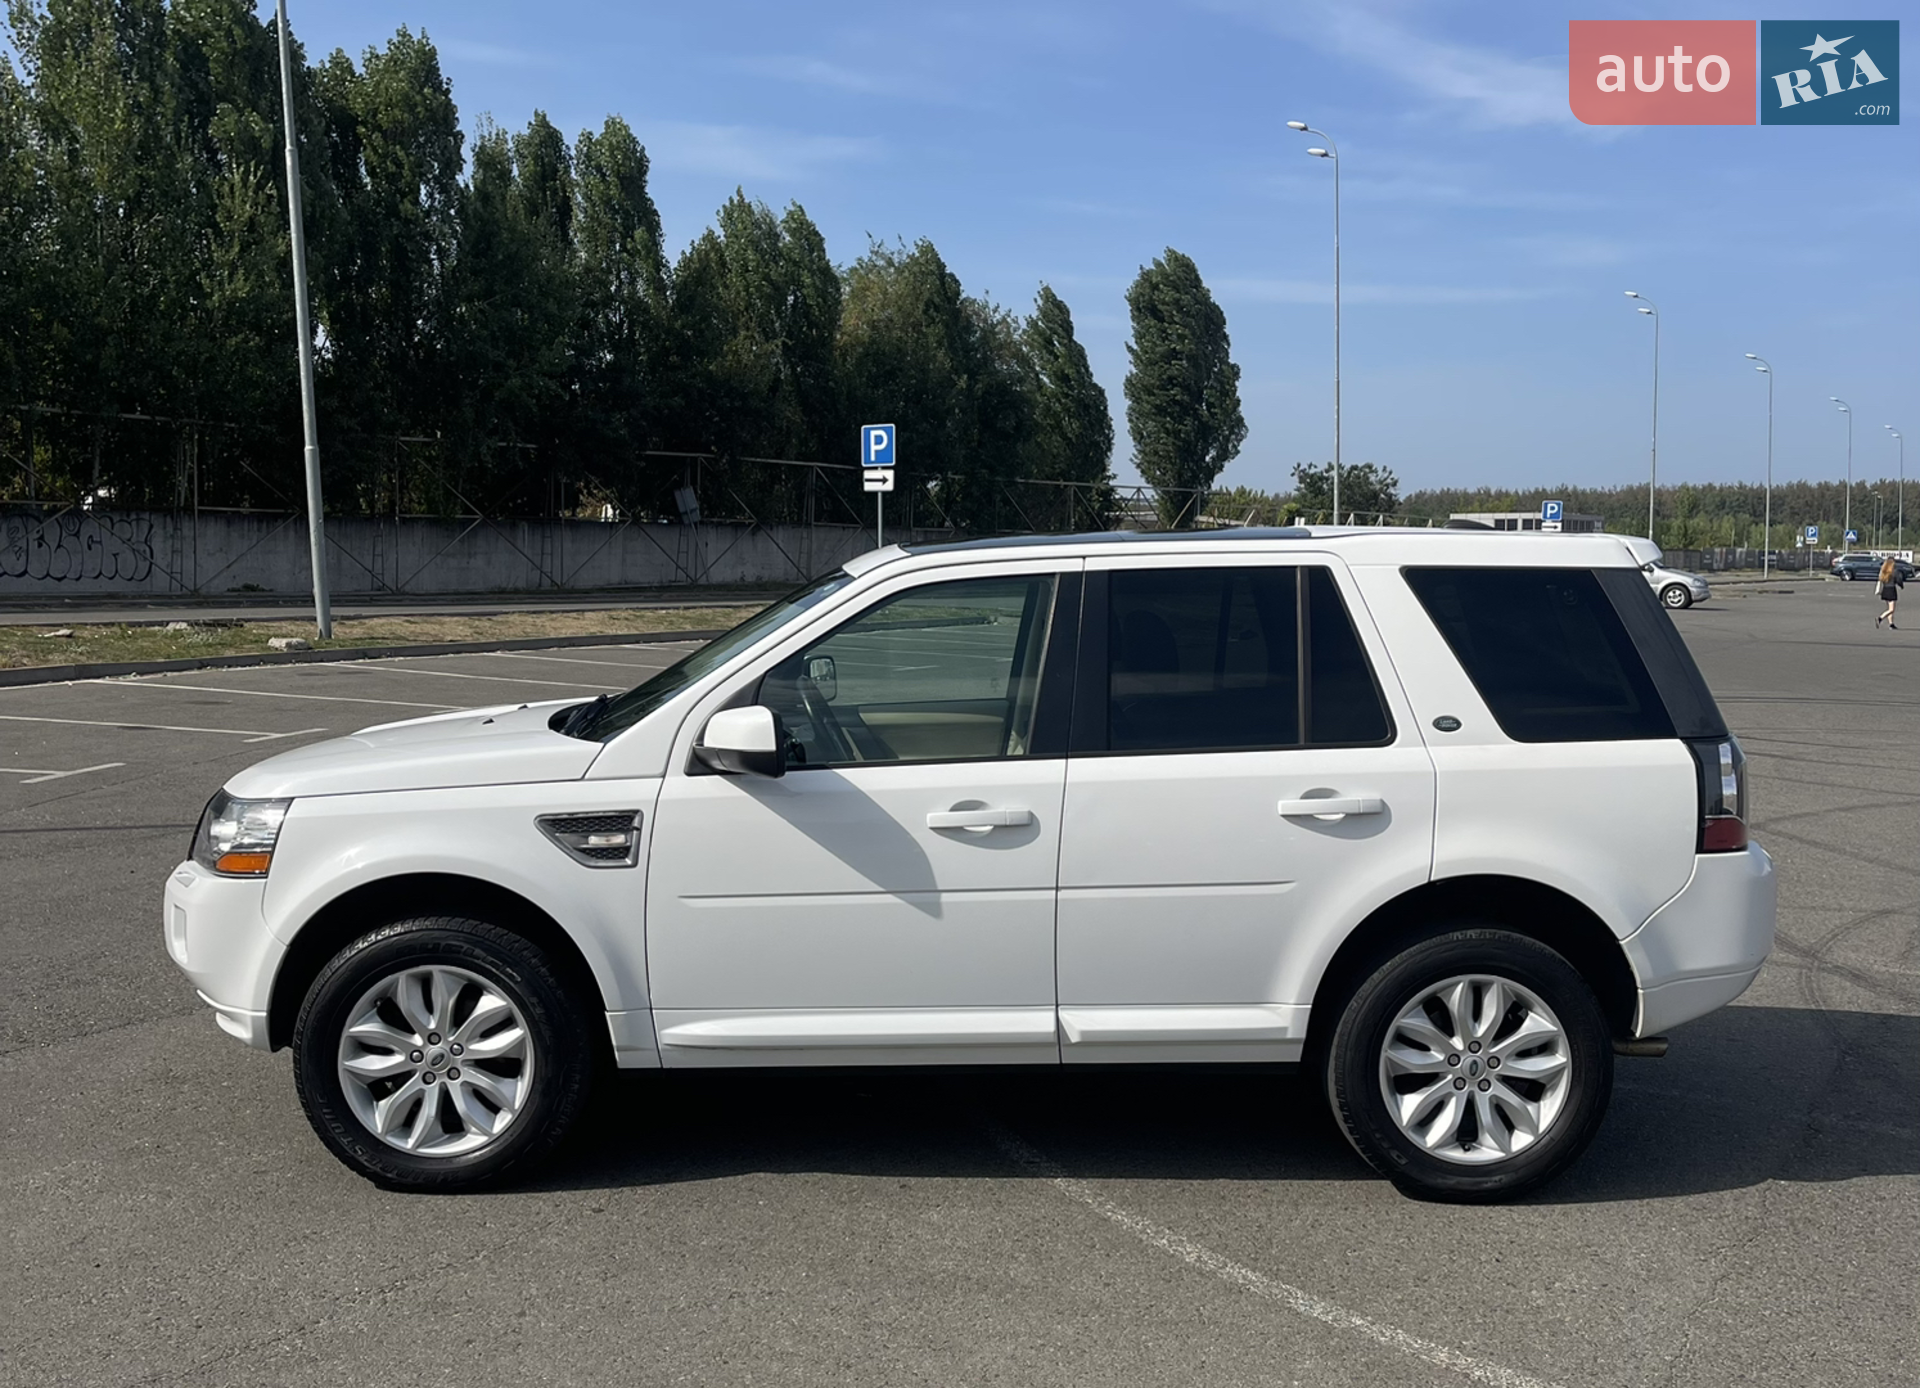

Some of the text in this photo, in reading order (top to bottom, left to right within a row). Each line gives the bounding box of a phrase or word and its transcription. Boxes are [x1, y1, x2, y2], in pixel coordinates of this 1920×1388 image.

[870, 430, 888, 461] P
[1547, 503, 1558, 518] P
[1808, 526, 1816, 537] P
